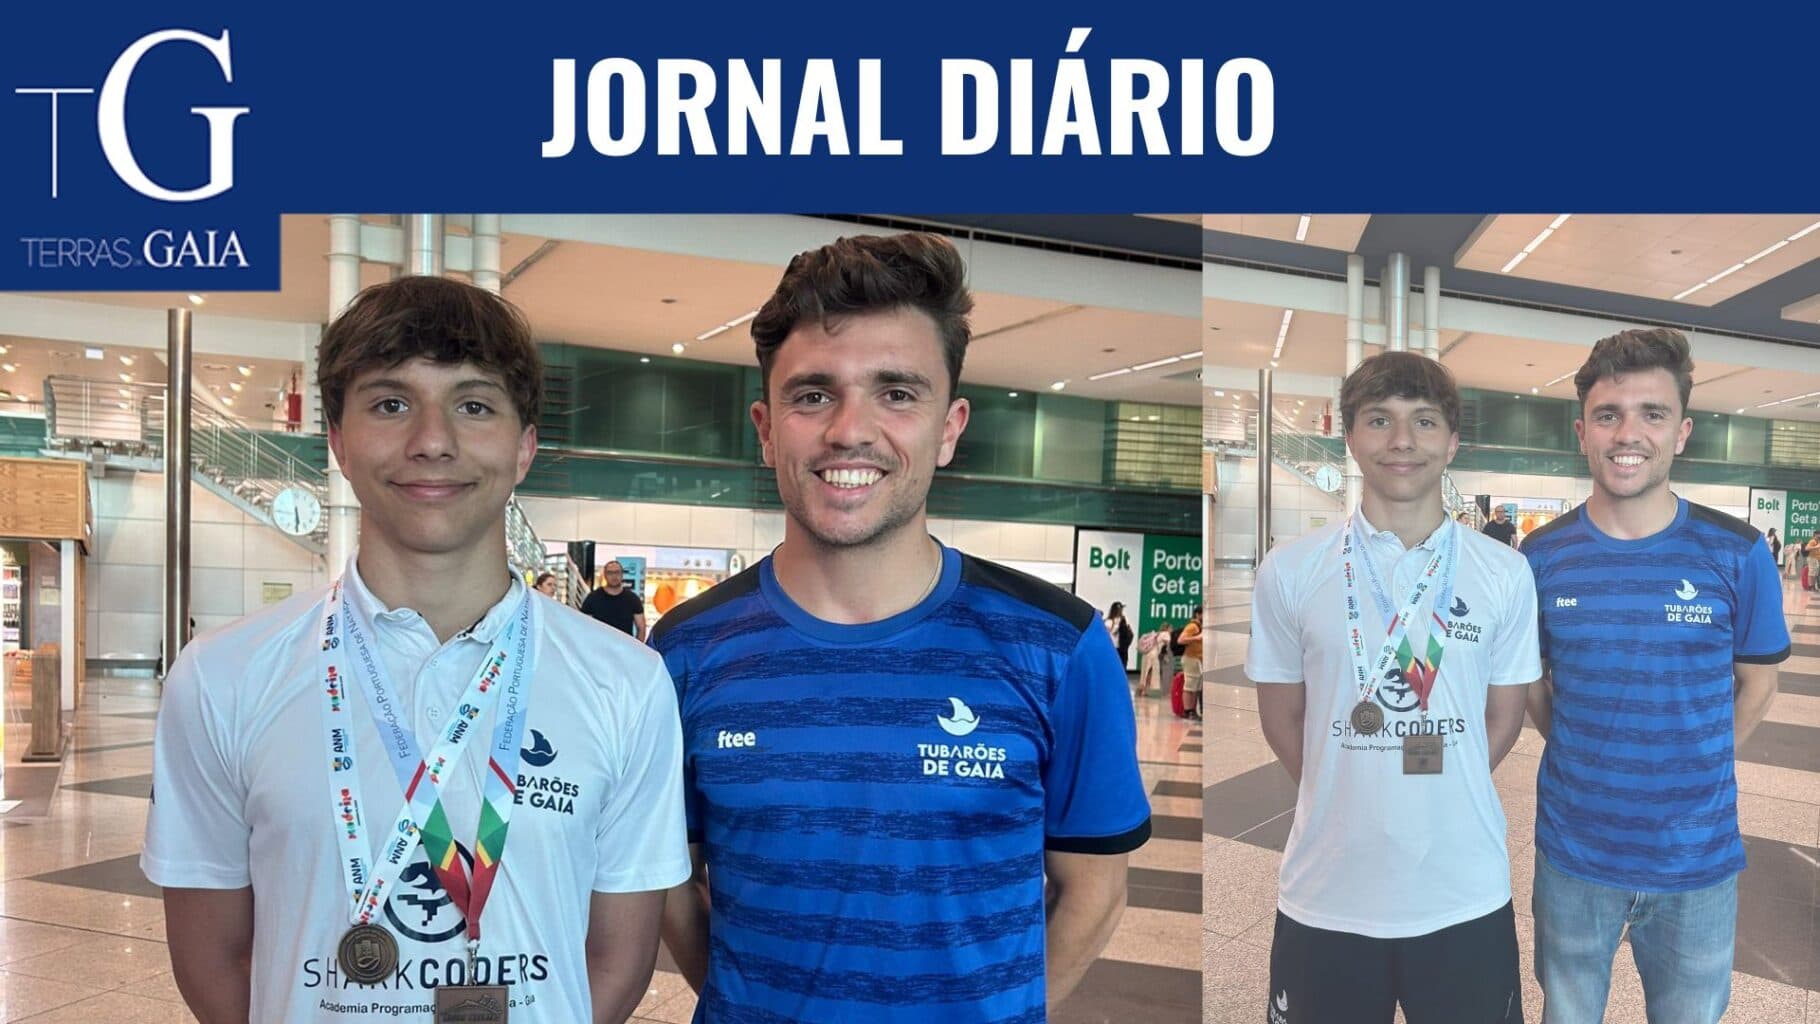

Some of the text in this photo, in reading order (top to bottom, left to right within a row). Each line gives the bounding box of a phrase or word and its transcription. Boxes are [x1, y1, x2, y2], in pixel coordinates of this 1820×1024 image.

[1757, 497, 1780, 513] Bolt
[1791, 512, 1817, 524] Get a
[1790, 526, 1800, 537] in
[1089, 546, 1130, 575] Bolt
[1153, 549, 1202, 571] Porto
[1152, 574, 1200, 595] Get a
[1150, 598, 1167, 618] in
[325, 614, 336, 636] ANM
[1448, 621, 1481, 634] BARÕES
[1667, 613, 1712, 624] DE GAIA
[1455, 631, 1479, 643] GAIA
[449, 719, 469, 744] ANM
[1332, 718, 1465, 738] SHKCODERS
[333, 728, 344, 753] ANM
[718, 730, 756, 749] ftee
[917, 743, 1007, 761] TUBARÕES
[923, 760, 1005, 779] DE GAIA
[516, 774, 580, 798] BARÕES
[513, 789, 574, 816] E GAIA
[389, 837, 409, 866] ANM
[352, 857, 364, 886] ANM
[303, 953, 549, 990] SHKCODERS
[319, 998, 368, 1014] Academia
[371, 1003, 437, 1017] Programaç
